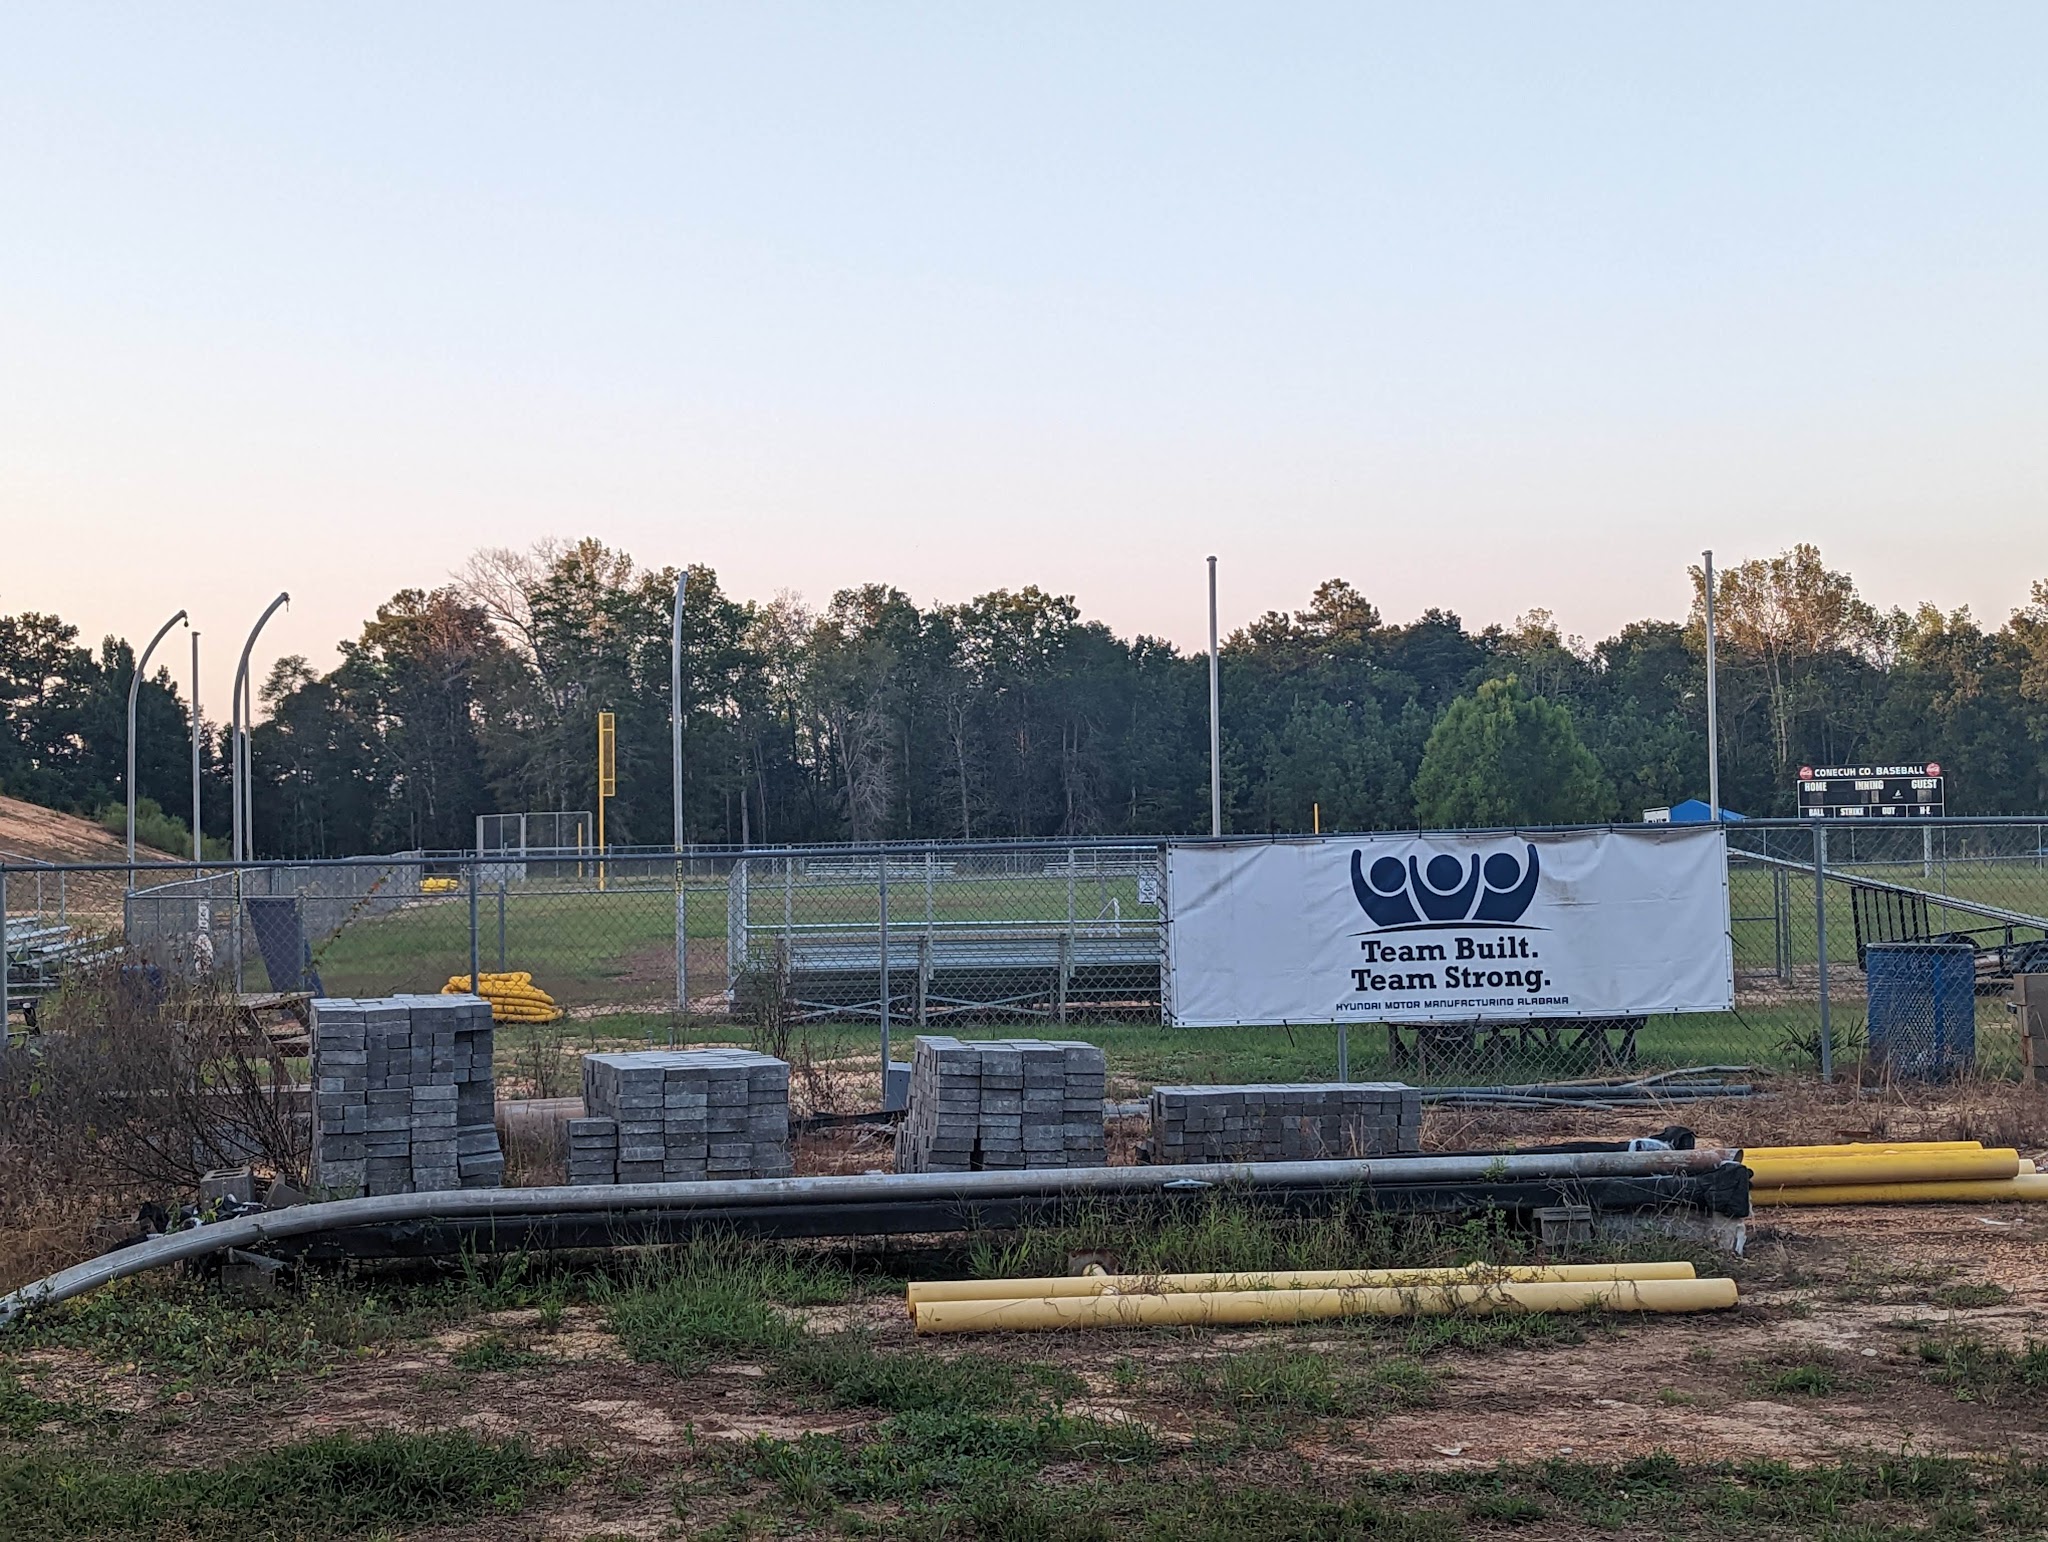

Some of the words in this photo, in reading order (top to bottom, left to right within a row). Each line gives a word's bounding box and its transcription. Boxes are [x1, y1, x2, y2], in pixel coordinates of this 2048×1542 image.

[1814, 768, 1856, 777] CONECUH
[1859, 767, 1874, 776] CO.
[1876, 766, 1925, 775] BASEBALL
[1804, 782, 1827, 791] HOME
[1911, 779, 1937, 789] GUEST
[1808, 808, 1824, 816] BALL
[1840, 807, 1864, 816] STRIKE
[1882, 807, 1896, 815] OUT
[1361, 940, 1447, 963] Team
[1454, 936, 1539, 960] Built.
[1351, 968, 1437, 992] Team
[1445, 965, 1551, 993] Strong.
[1335, 1001, 1381, 1012] HYUNDAI
[1385, 1000, 1420, 1010] MOTOR
[1424, 998, 1514, 1009] MANUFACTURING
[1517, 996, 1569, 1006] ALABAMA
